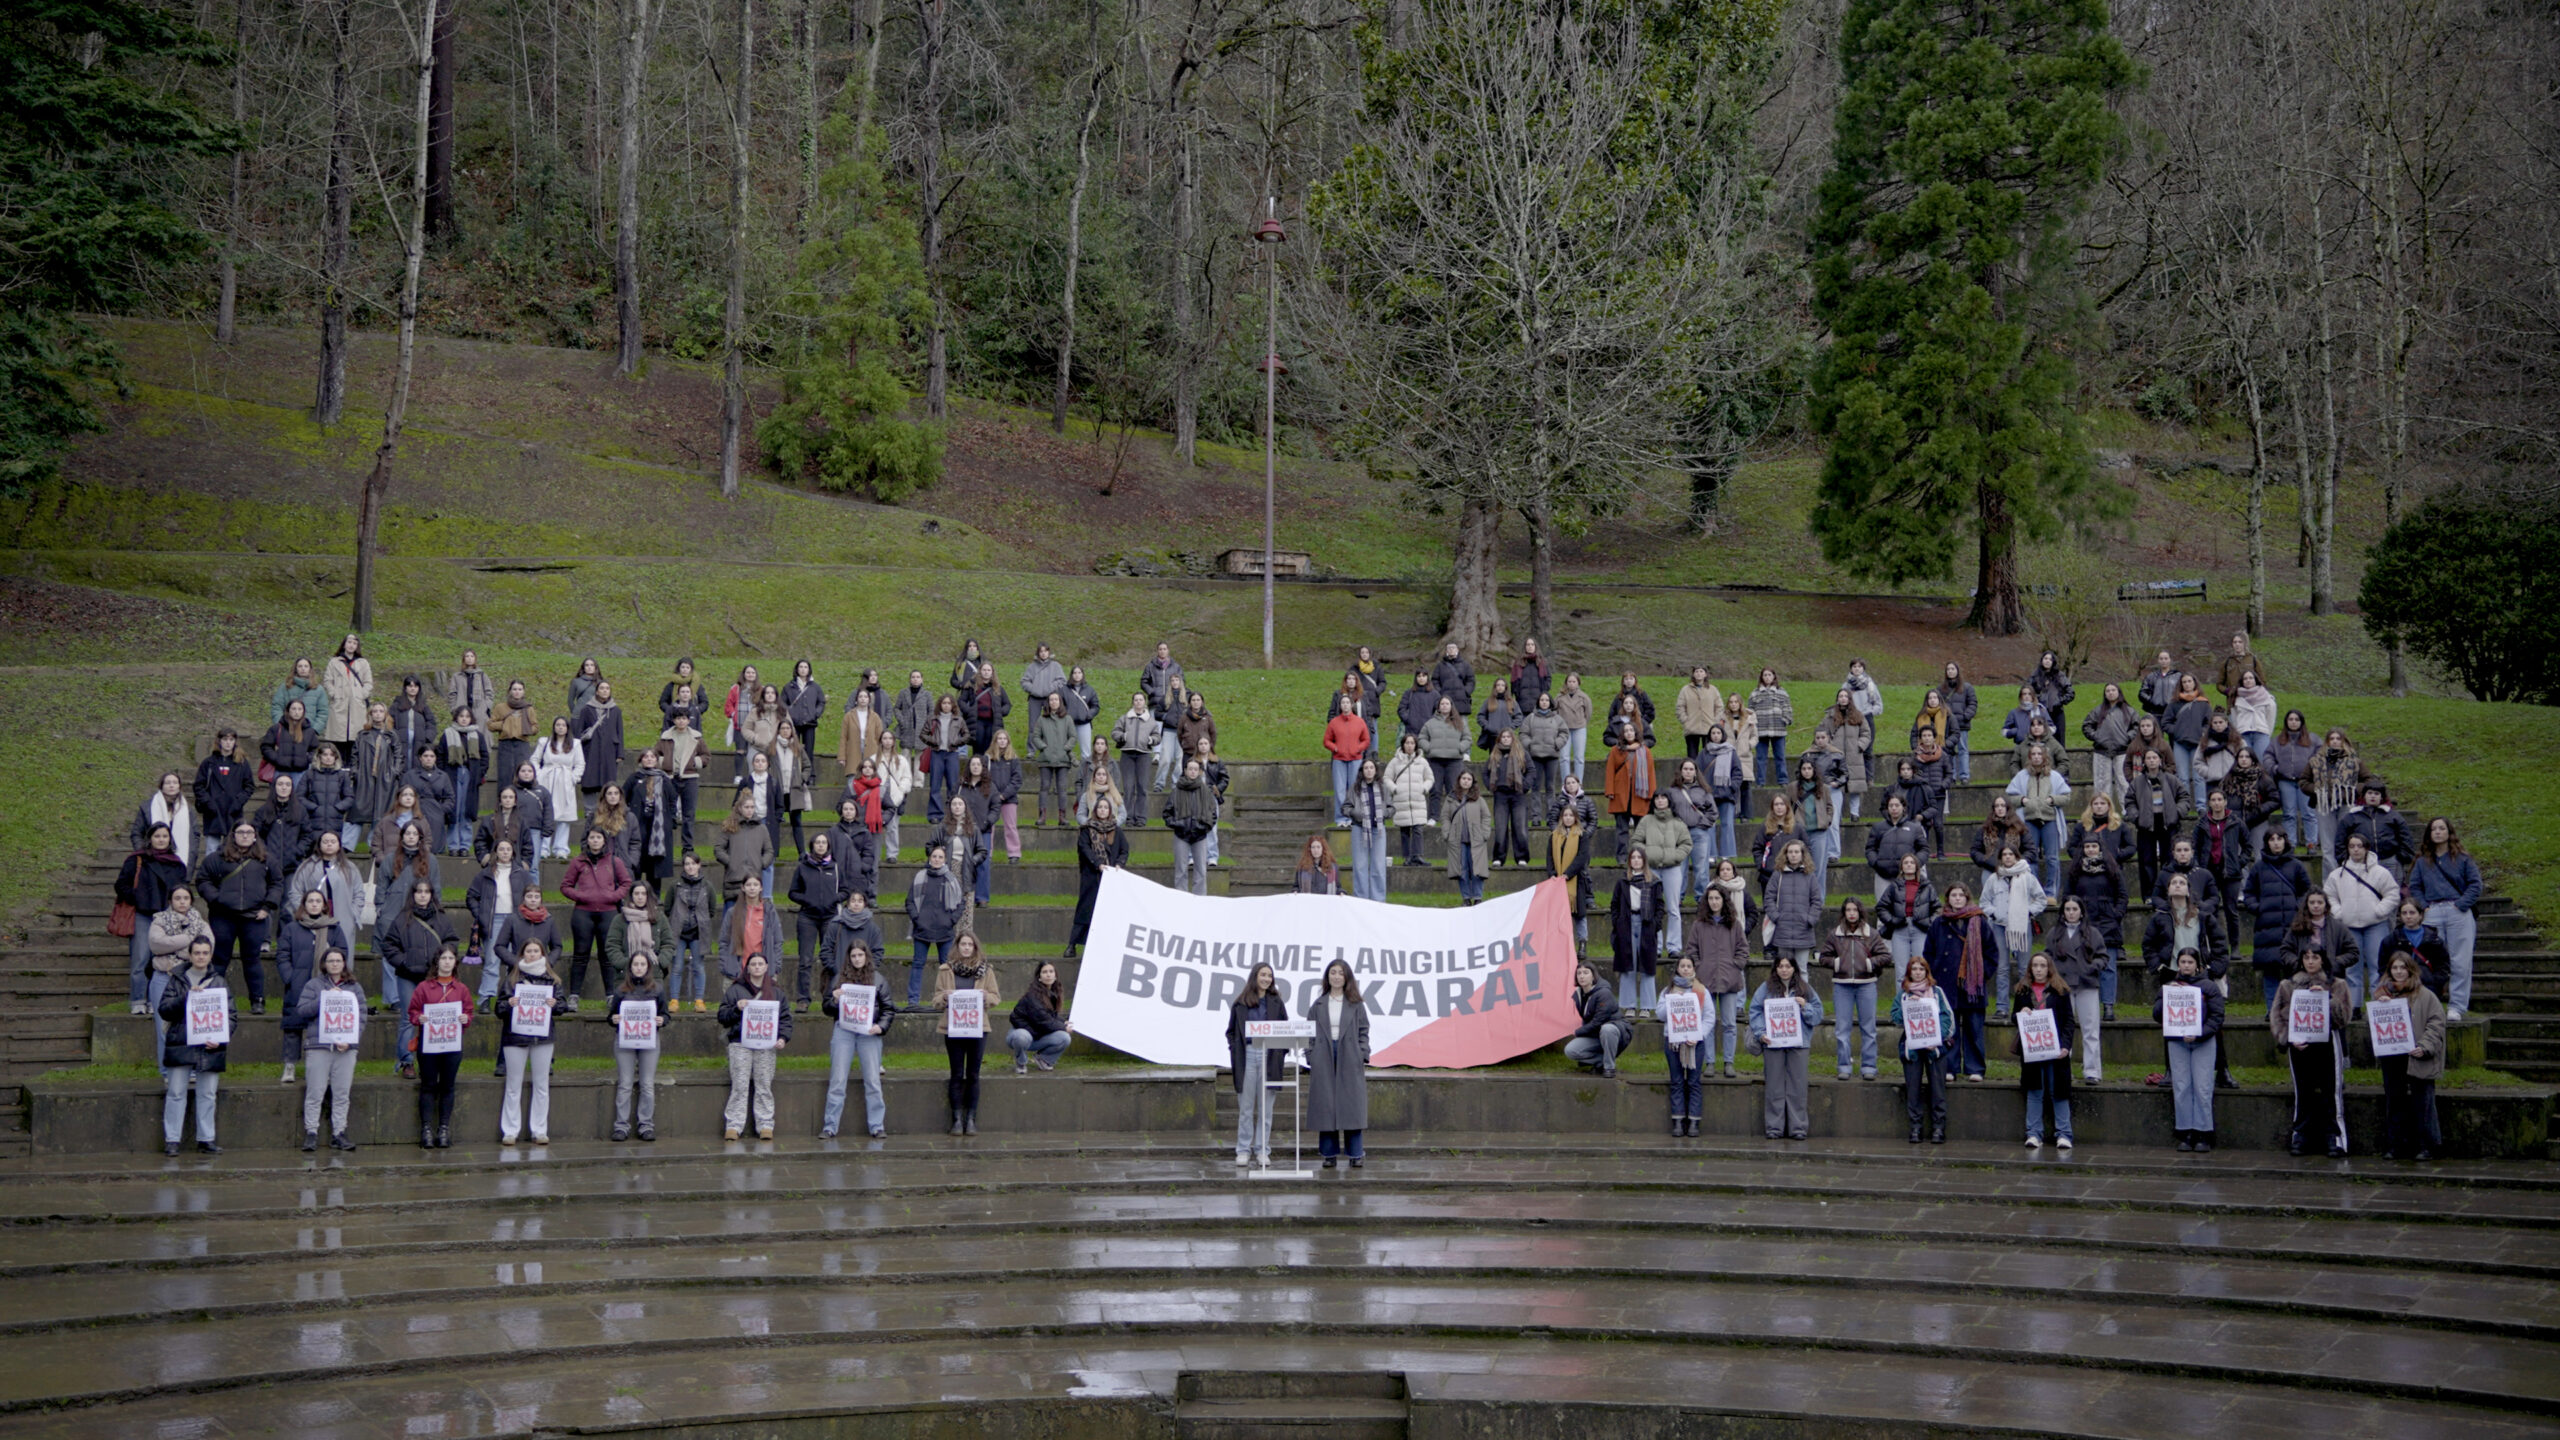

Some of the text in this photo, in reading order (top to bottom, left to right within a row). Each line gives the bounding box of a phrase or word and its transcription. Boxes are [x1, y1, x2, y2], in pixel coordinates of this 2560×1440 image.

[1125, 923, 1323, 972] EMAKUME
[192, 1010, 224, 1030] M8
[324, 1011, 354, 1030] M8
[518, 1004, 546, 1023] M8
[844, 1002, 870, 1022] M8
[952, 1008, 978, 1025] M8
[1671, 1012, 1697, 1030] M8
[2168, 1005, 2196, 1023] M8
[2294, 1009, 2324, 1029] M8
[429, 1023, 457, 1040] M8
[624, 1020, 652, 1037] M8
[747, 1019, 773, 1037] M8
[1250, 1024, 1270, 1034] M8
[1770, 1017, 1796, 1035] M8
[1908, 1018, 1935, 1036] M8
[2375, 1021, 2408, 1040] M8
[2025, 1031, 2054, 1049] M8
